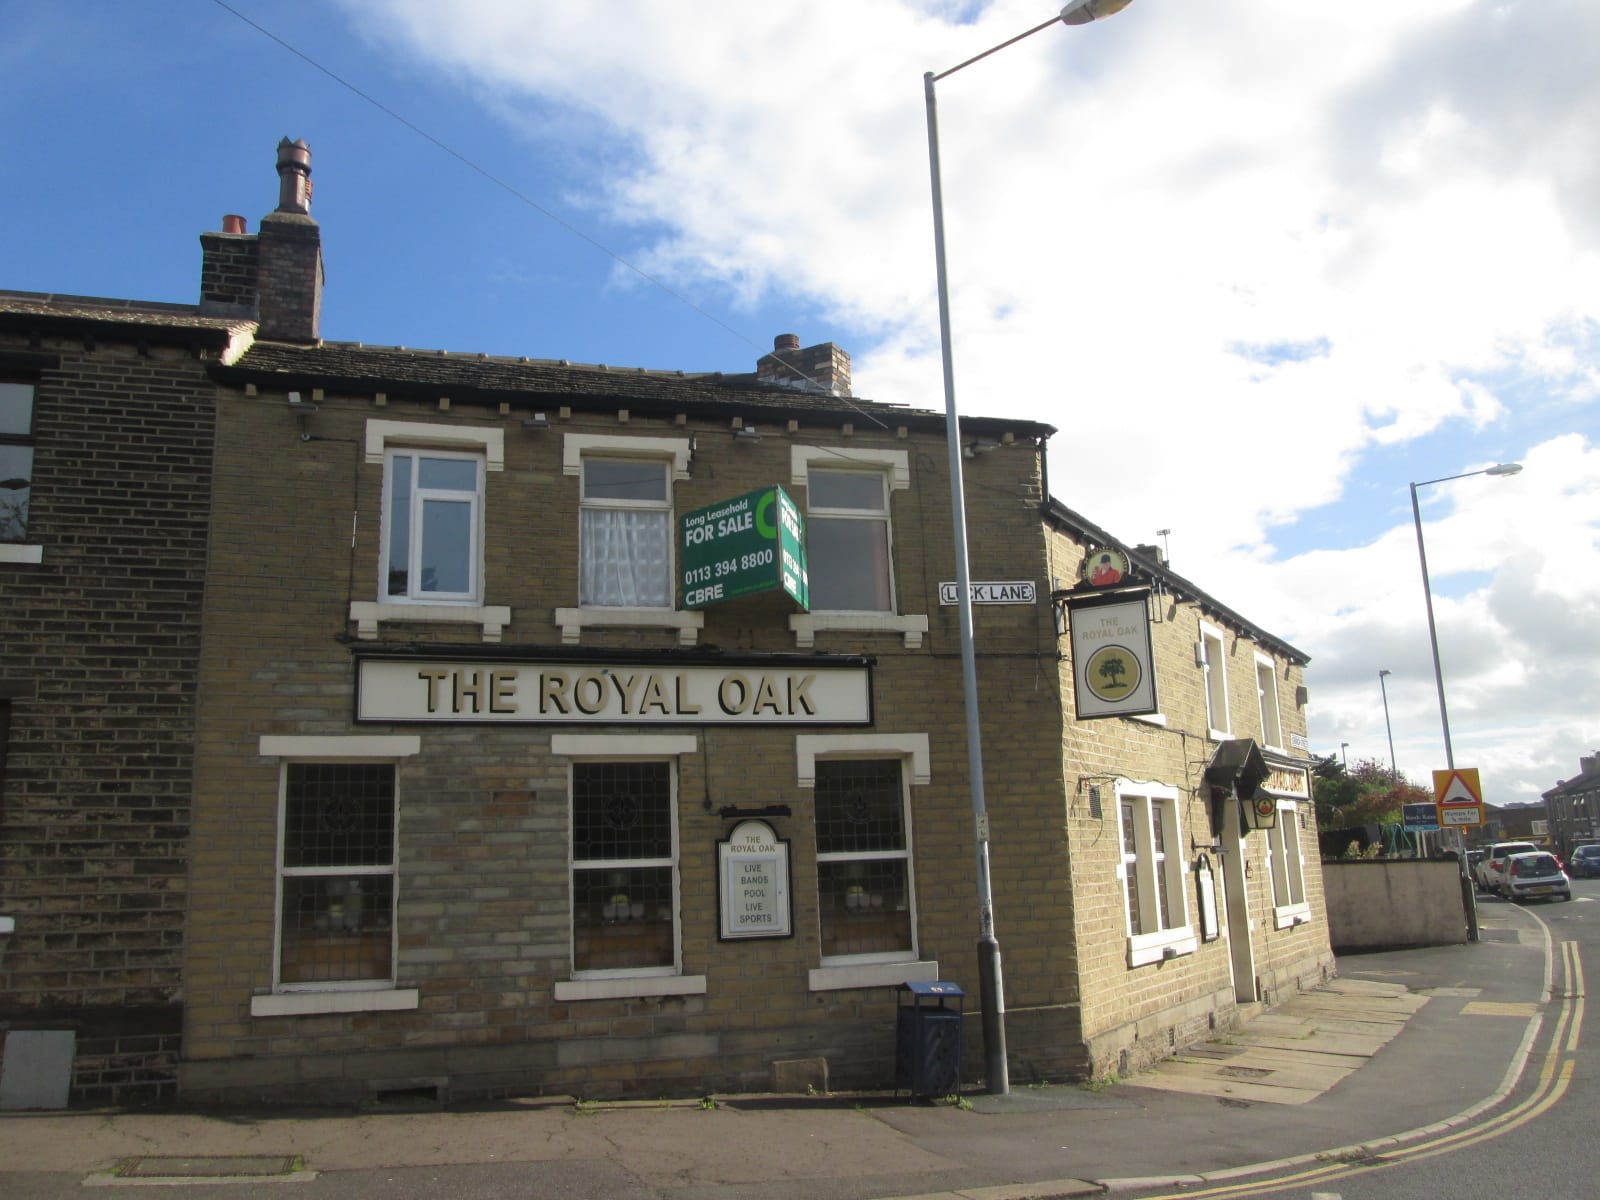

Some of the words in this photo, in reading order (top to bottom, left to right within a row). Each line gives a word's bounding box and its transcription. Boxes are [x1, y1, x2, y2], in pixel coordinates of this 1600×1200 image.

[685, 515, 705, 527] Long
[707, 499, 748, 519] Leasehold
[685, 524, 714, 547] FOR
[718, 512, 753, 538] SALE
[685, 566, 711, 585] 0113
[714, 559, 738, 577] 394
[741, 548, 773, 570] 8800
[685, 583, 724, 606] CBRE
[990, 585, 1029, 600] LANE
[1100, 616, 1119, 627] THE
[1082, 628, 1114, 641] ROYAL
[1117, 625, 1137, 636] OAK
[418, 668, 518, 714] THE
[539, 670, 702, 715] ROYAL
[717, 672, 817, 715] OAK
[745, 836, 761, 844] THE
[730, 845, 756, 853] ROYAL
[759, 844, 775, 852] OAK
[744, 864, 762, 873] LIVE
[741, 876, 769, 885] BANDS
[744, 889, 766, 898] POOL
[745, 902, 763, 911] LIVE
[739, 913, 772, 923] SPORTS
